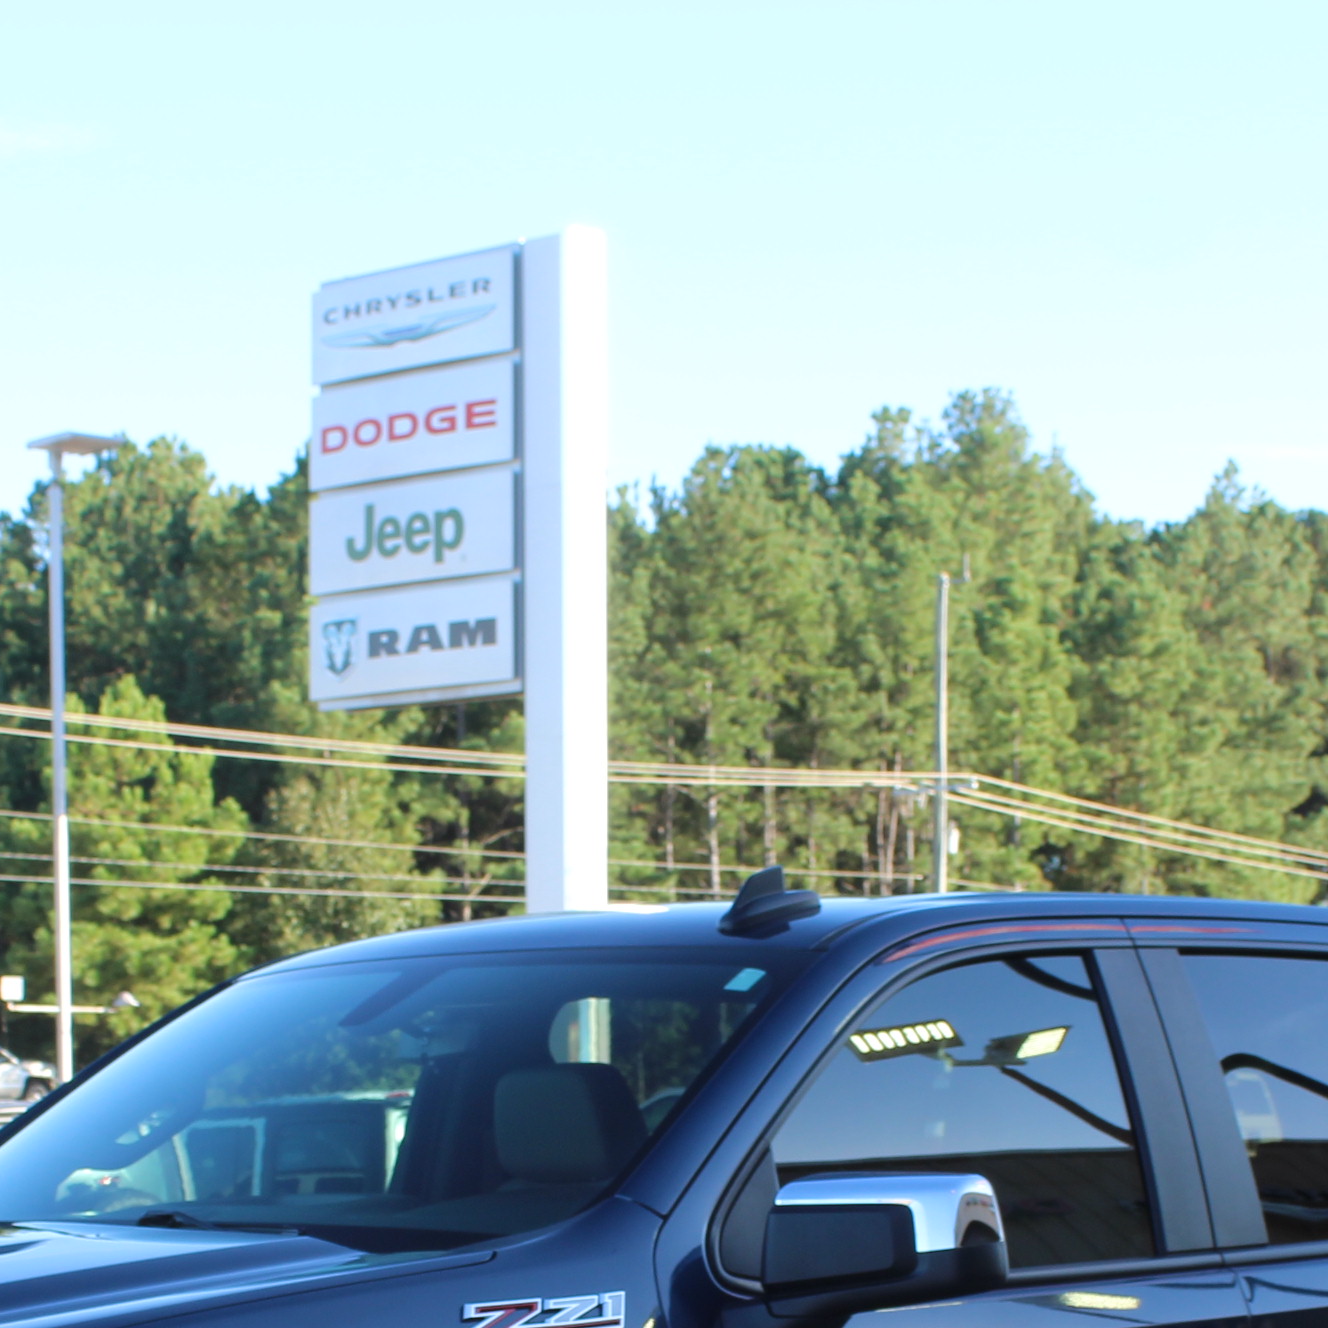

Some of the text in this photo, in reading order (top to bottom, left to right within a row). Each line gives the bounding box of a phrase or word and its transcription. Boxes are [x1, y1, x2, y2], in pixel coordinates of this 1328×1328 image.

[323, 277, 492, 325] CHRYSLER
[321, 399, 498, 454] DODGE
[345, 504, 465, 564] Jeep
[368, 617, 498, 659] RAM
